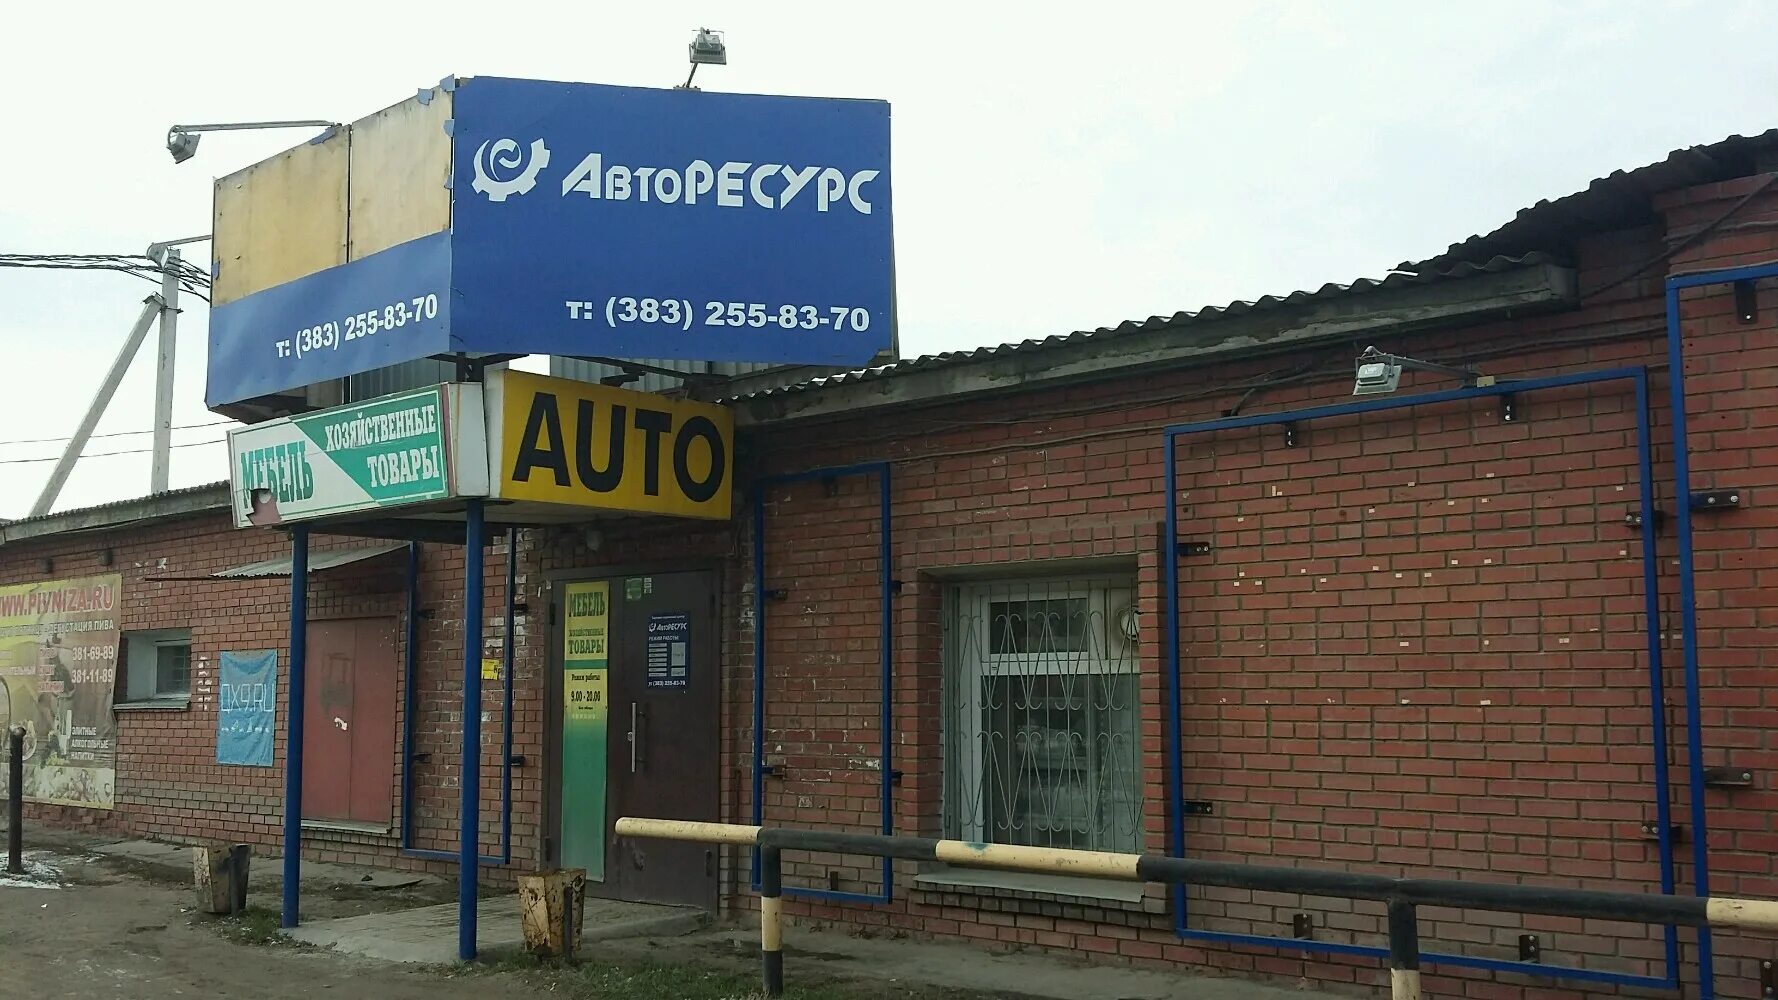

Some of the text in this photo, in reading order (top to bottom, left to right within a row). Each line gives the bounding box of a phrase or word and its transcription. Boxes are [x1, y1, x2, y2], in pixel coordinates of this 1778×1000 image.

[295, 320, 340, 360] (383)
[344, 293, 438, 341] 255-83-70
[605, 296, 694, 331] (383)
[704, 300, 871, 332] 255-83-70
[324, 404, 437, 452] ХОЗЯЙСТВЕННЫЕ
[511, 391, 726, 503] AUTO
[240, 440, 314, 509] МЕБЕЛЬ
[366, 445, 440, 488] ТОВАРЫ
[0, 584, 115, 617] WW.PIVNIZA.RU
[568, 591, 606, 618] МЕБЕЛЬ
[93, 619, 114, 631] ПИВА
[72, 644, 114, 661] 381-69-89
[568, 639, 605, 655] ТОВАРЫ
[71, 668, 113, 684] 381-11-89
[571, 690, 583, 702] 9.00
[586, 690, 601, 702] 20.00
